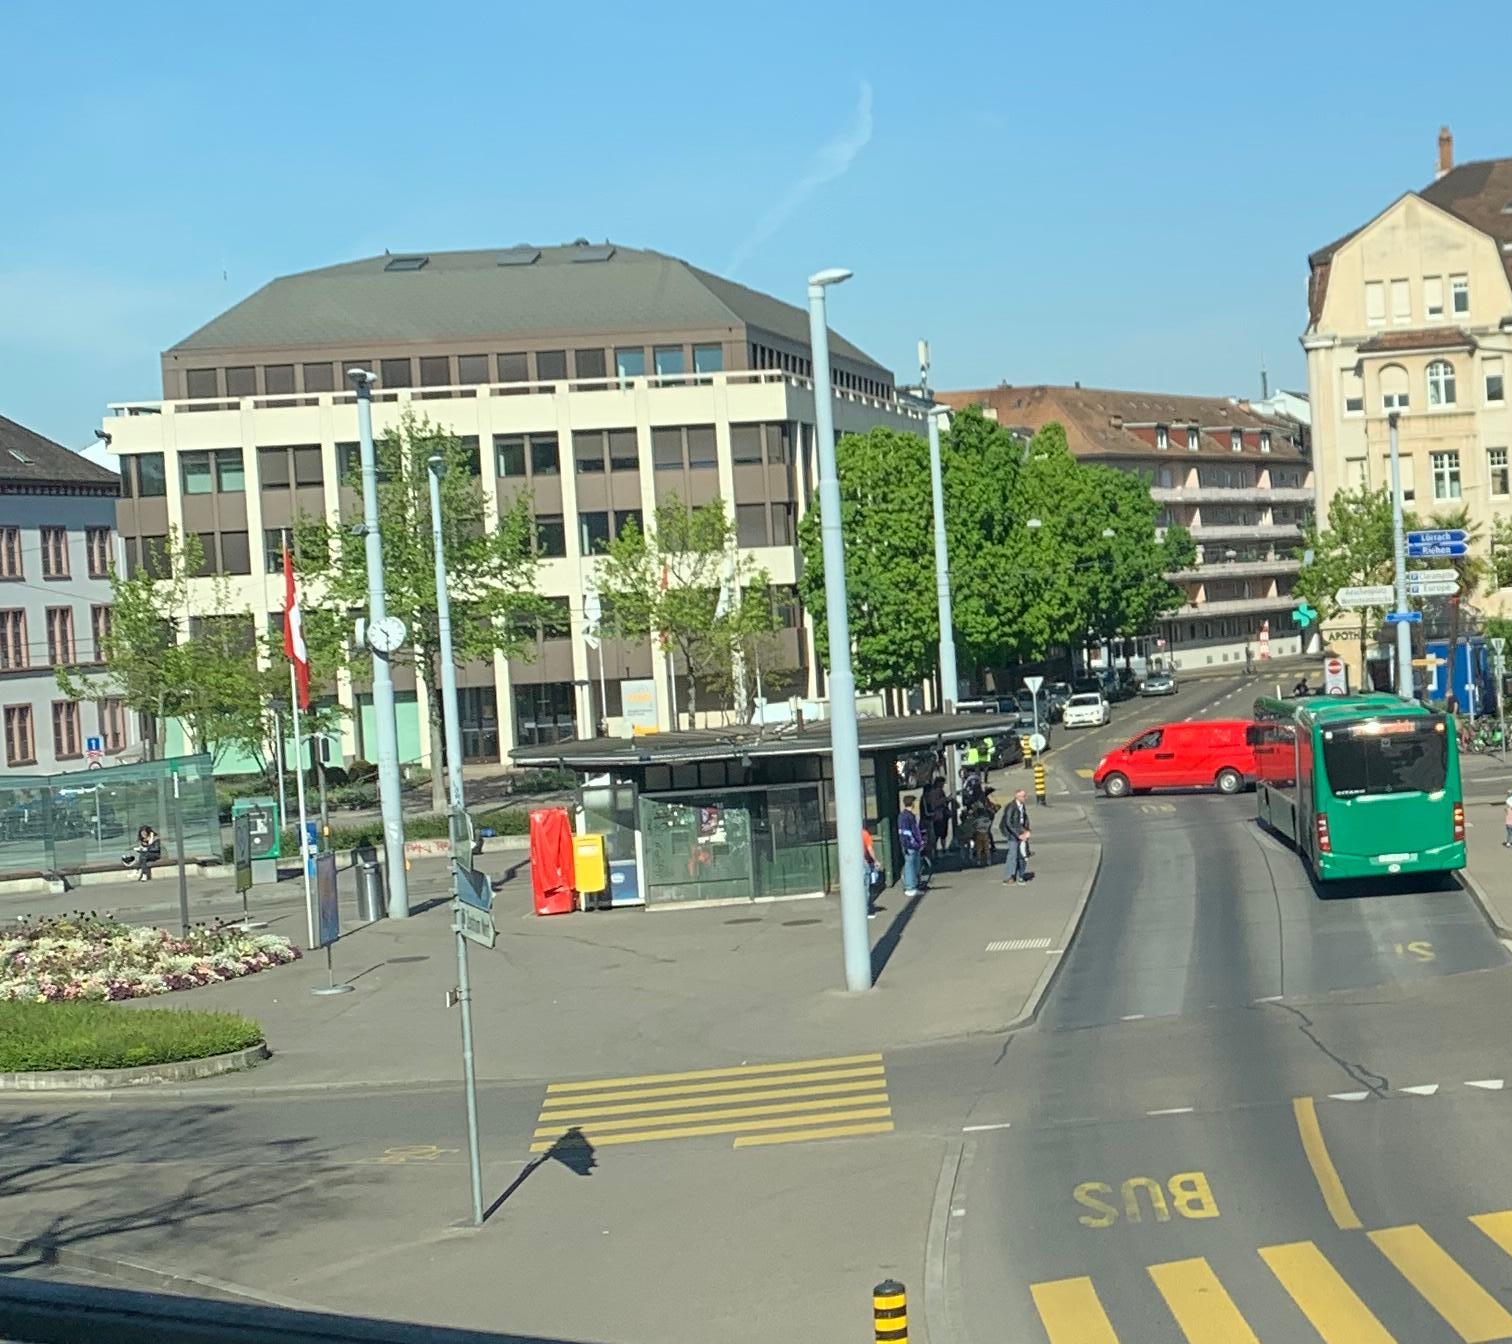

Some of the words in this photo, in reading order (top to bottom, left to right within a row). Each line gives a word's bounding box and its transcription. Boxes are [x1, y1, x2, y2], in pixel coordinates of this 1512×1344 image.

[1421, 532, 1451, 542] Lörrach
[1422, 545, 1451, 554] Riehen
[1424, 583, 1451, 592] Europe
[1073, 1171, 1221, 1228] BUS
